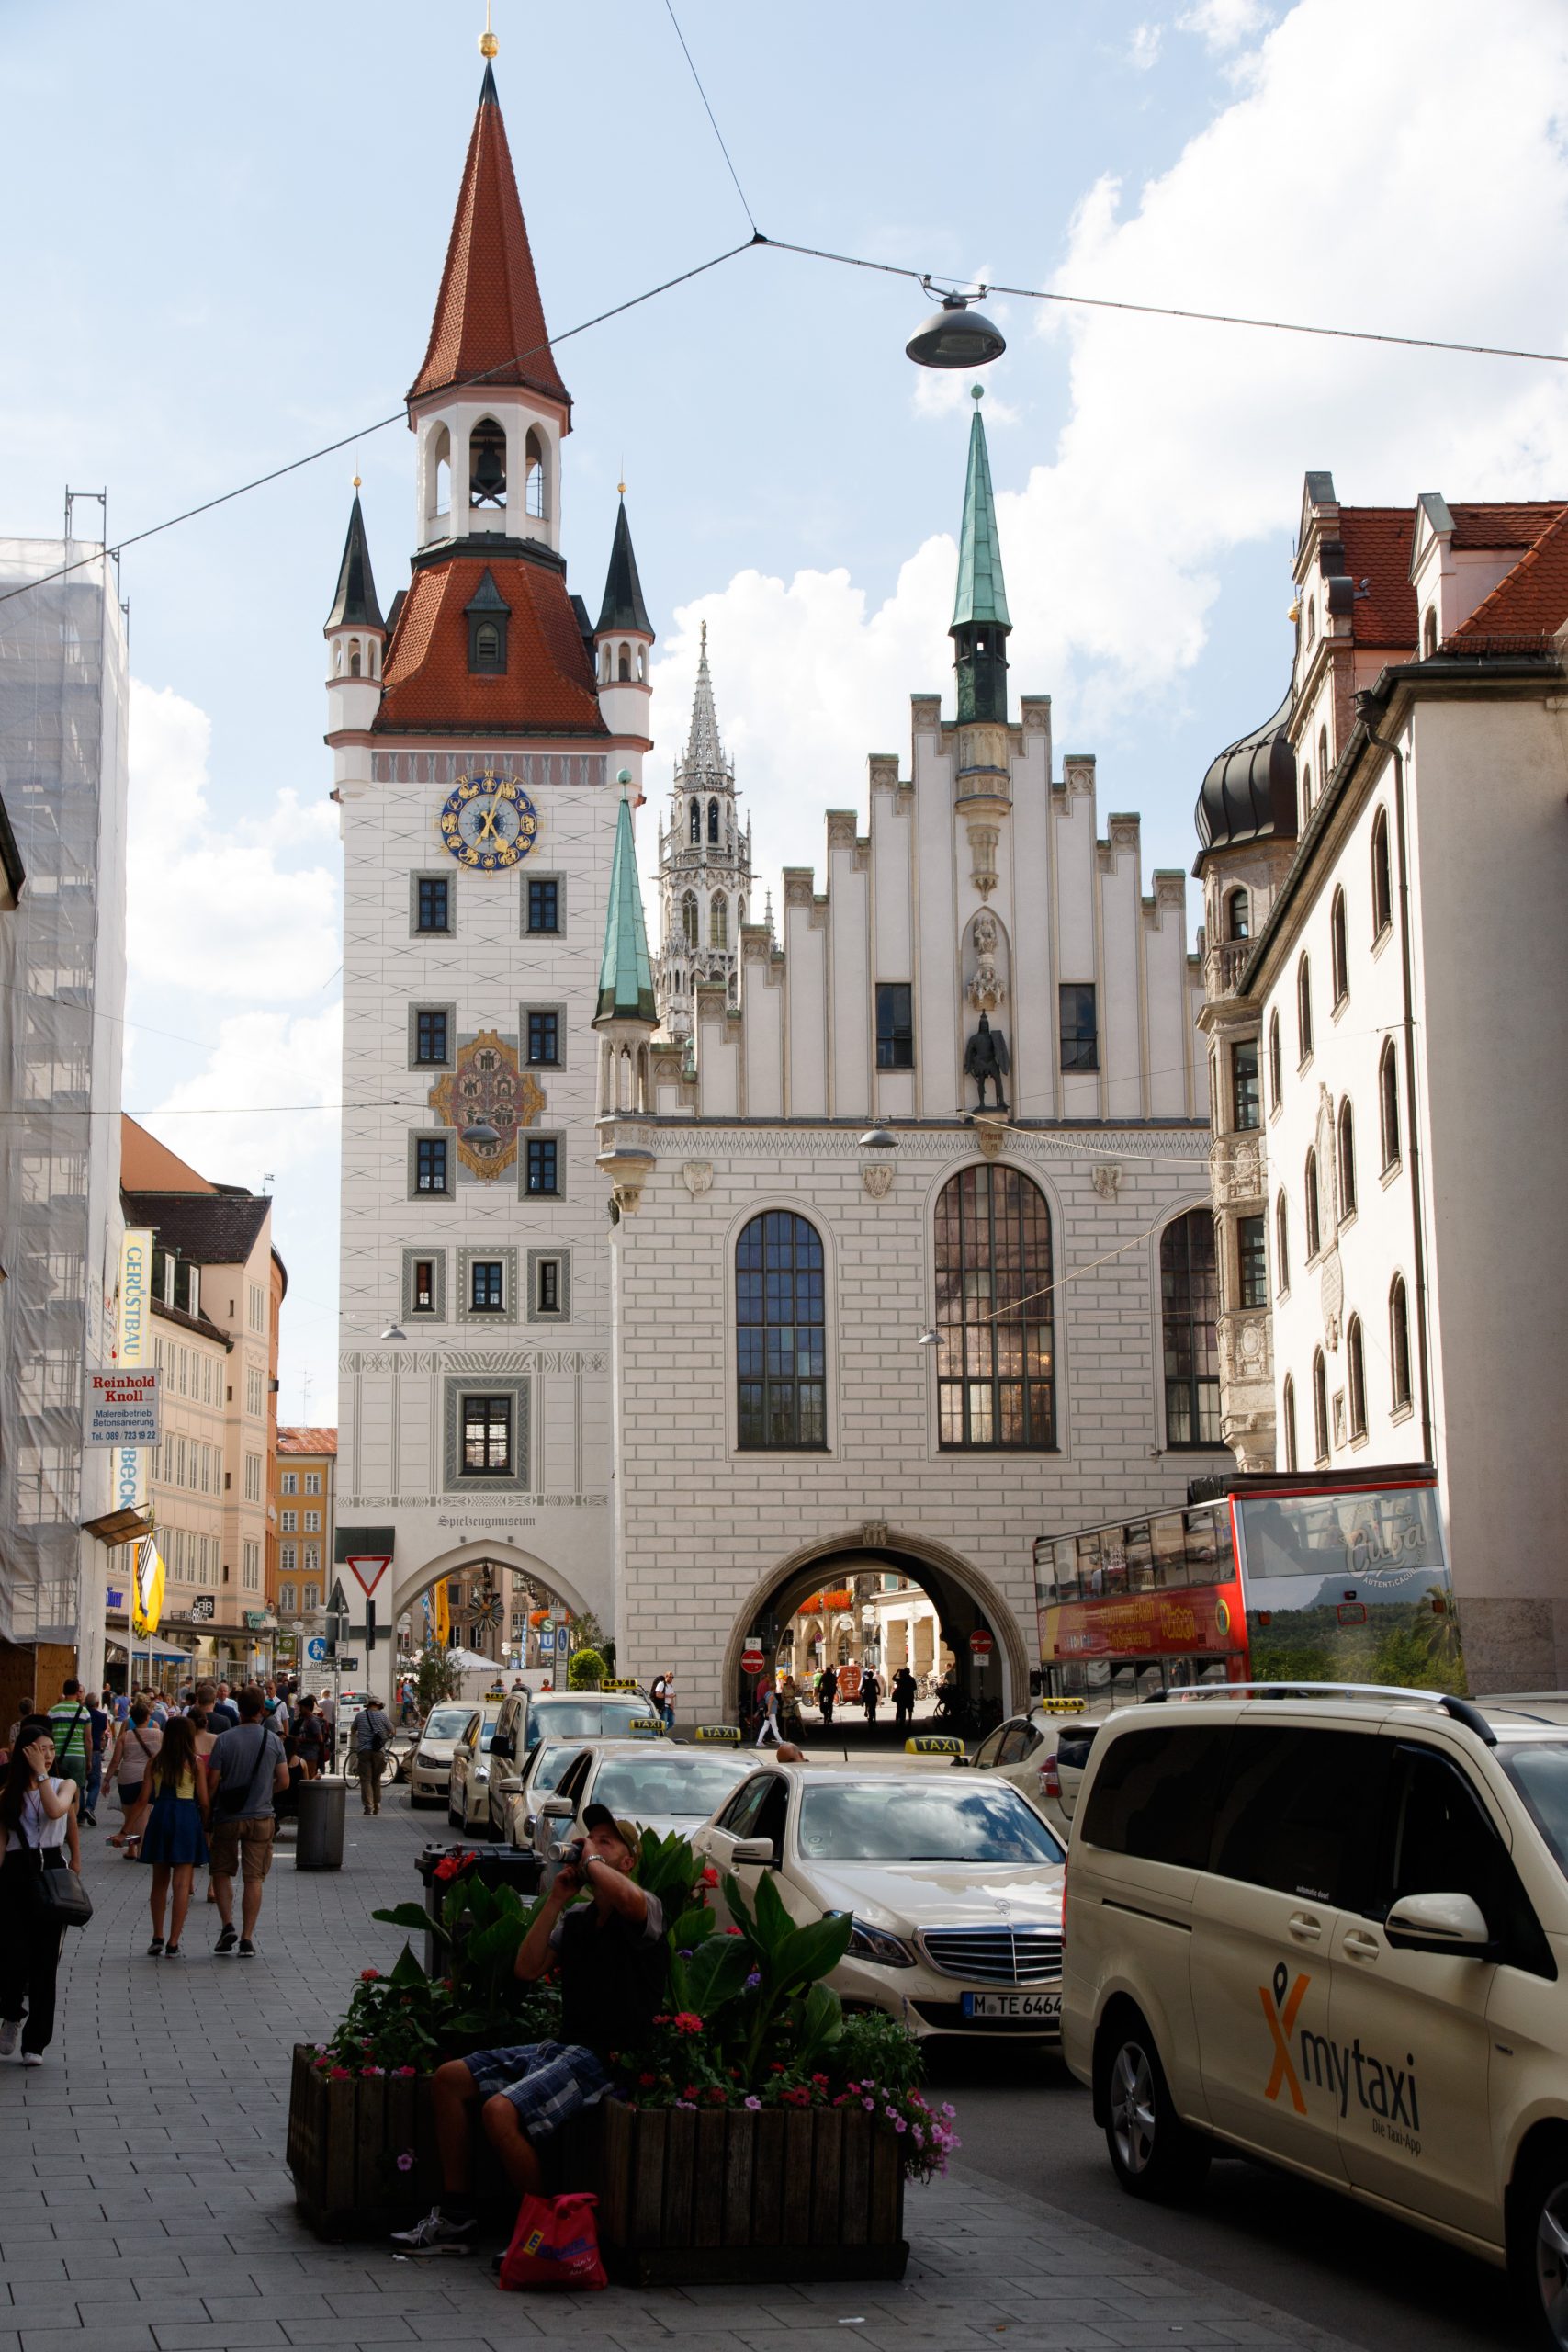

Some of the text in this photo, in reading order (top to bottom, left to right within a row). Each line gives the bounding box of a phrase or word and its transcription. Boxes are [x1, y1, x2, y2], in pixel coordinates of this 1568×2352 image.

[124, 1246, 147, 1356] GERÜSTBAU
[92, 1375, 155, 1388] Reinhold
[104, 1390, 143, 1402] Knoll
[96, 1409, 152, 1419] Malereibetrieb
[93, 1419, 154, 1428] Betonsanierung
[92, 1432, 103, 1441] Tel.
[106, 1431, 119, 1441] 089
[124, 1431, 137, 1441] 723
[138, 1431, 146, 1440] 19
[146, 1431, 156, 1440] 22
[437, 1515, 536, 1529] Spielzeugmuseum
[1347, 1523, 1426, 1577] Cuba
[543, 1619, 553, 1632] S
[543, 1634, 552, 1646] U
[512, 1650, 518, 1658] S
[512, 1659, 518, 1668] U
[705, 1727, 735, 1737] TAXI
[919, 1739, 958, 1751] TAXI
[974, 1996, 1062, 2014] M TE 6464
[1301, 2030, 1420, 2132] mytaxi
[1372, 2118, 1422, 2157] Die Taxi-App
